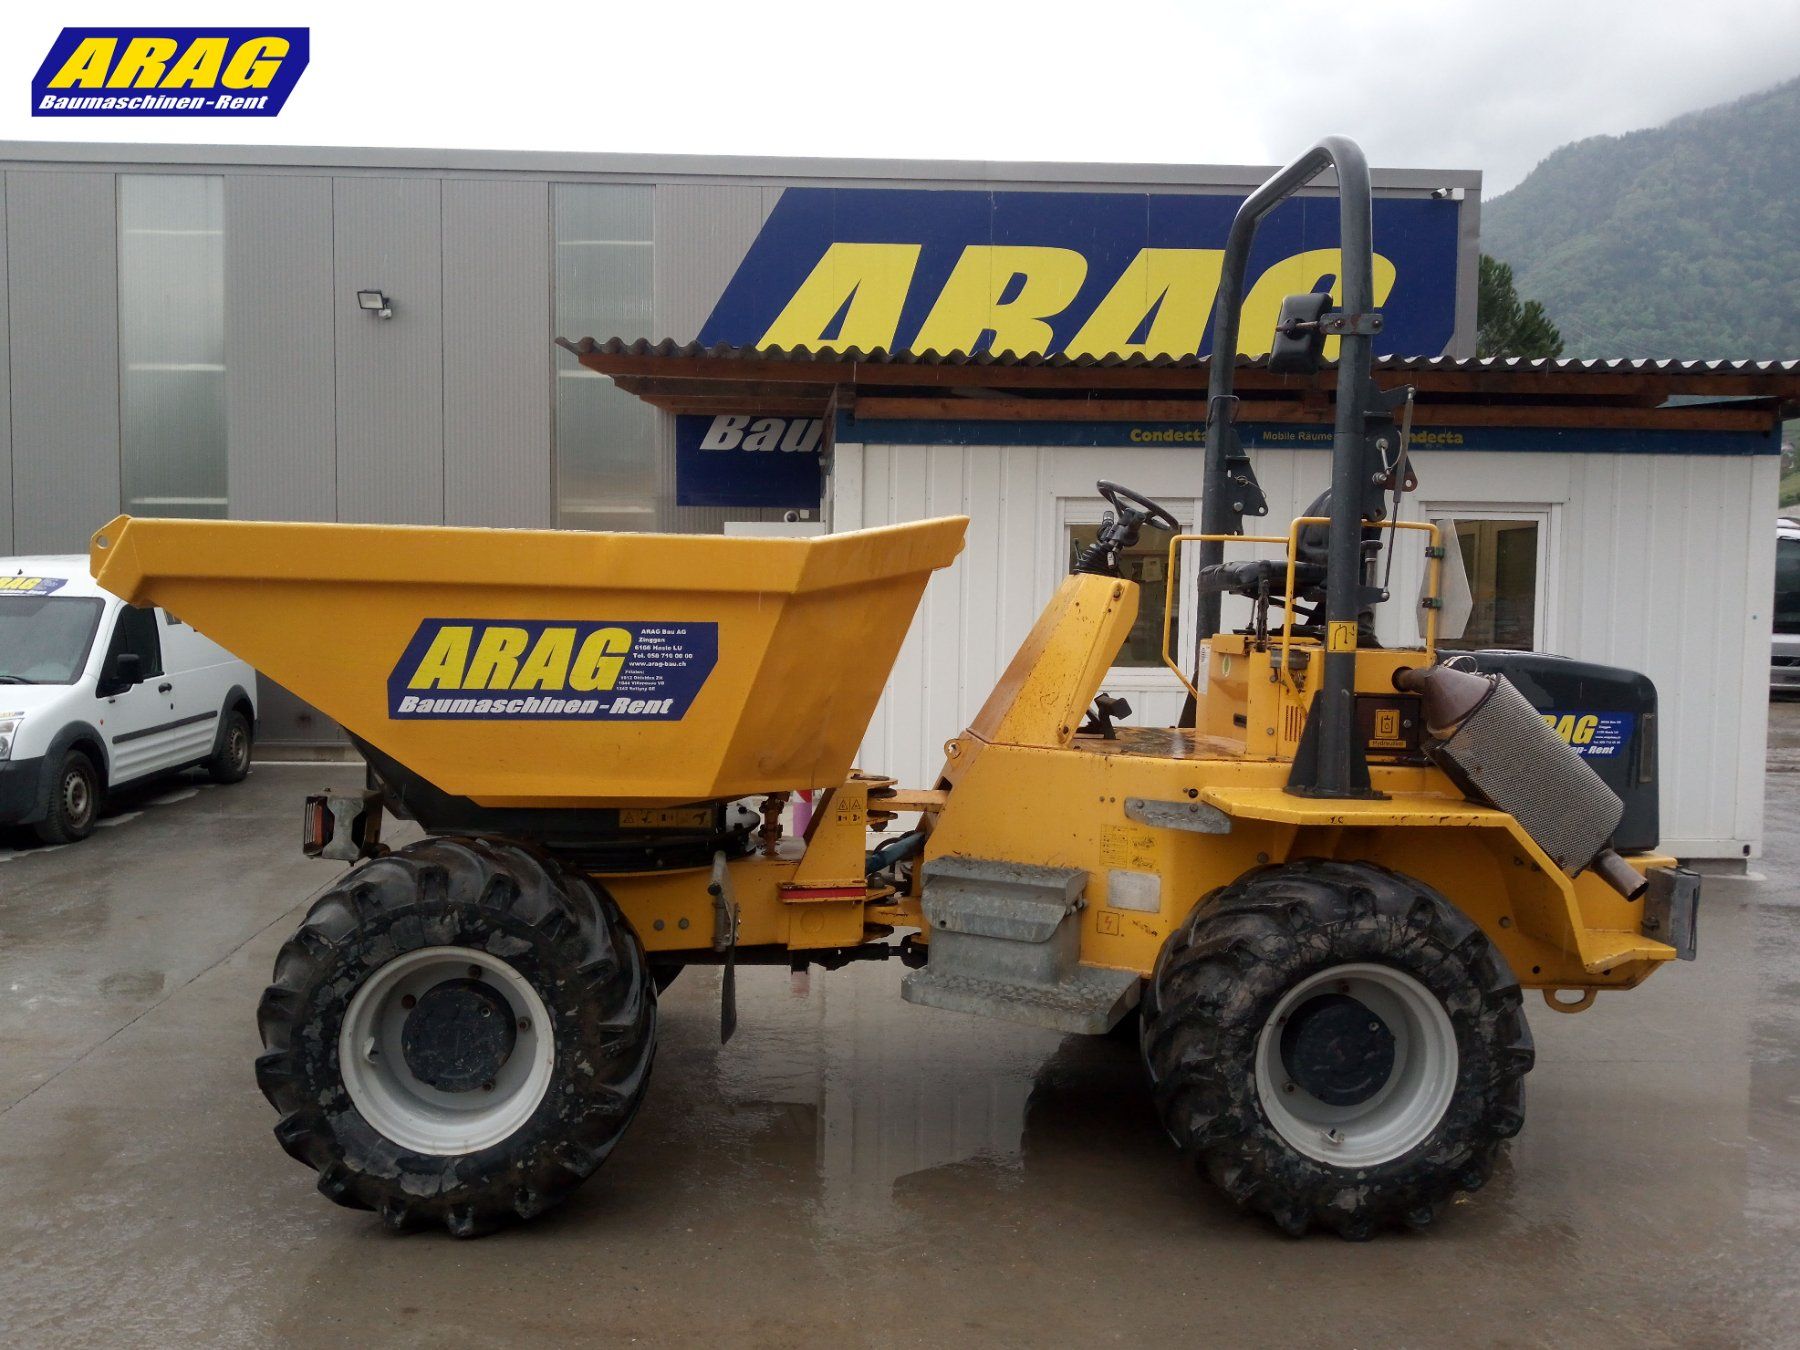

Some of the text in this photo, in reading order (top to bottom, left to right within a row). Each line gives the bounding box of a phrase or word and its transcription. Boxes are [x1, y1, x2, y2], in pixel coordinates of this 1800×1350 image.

[699, 415, 824, 452] Bau
[1263, 431, 1296, 440] Mobile
[1408, 430, 1464, 444] ndecta
[407, 626, 632, 691] ARAG
